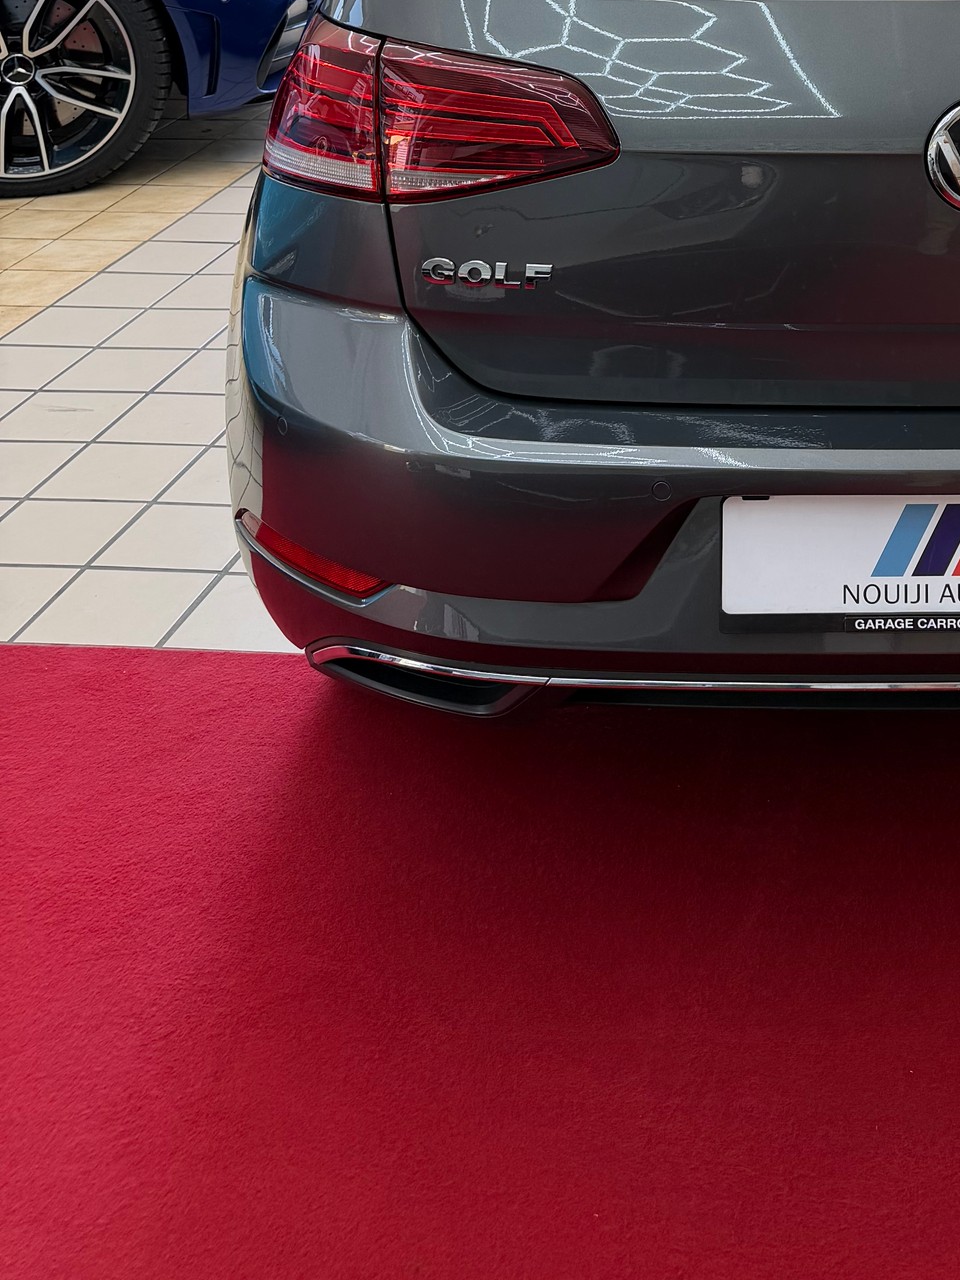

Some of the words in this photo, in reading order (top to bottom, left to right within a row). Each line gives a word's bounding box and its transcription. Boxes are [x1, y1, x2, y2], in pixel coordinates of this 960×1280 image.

[421, 257, 553, 289] GOLF
[843, 584, 929, 604] NOUIJI
[855, 618, 914, 629] GARAGE
